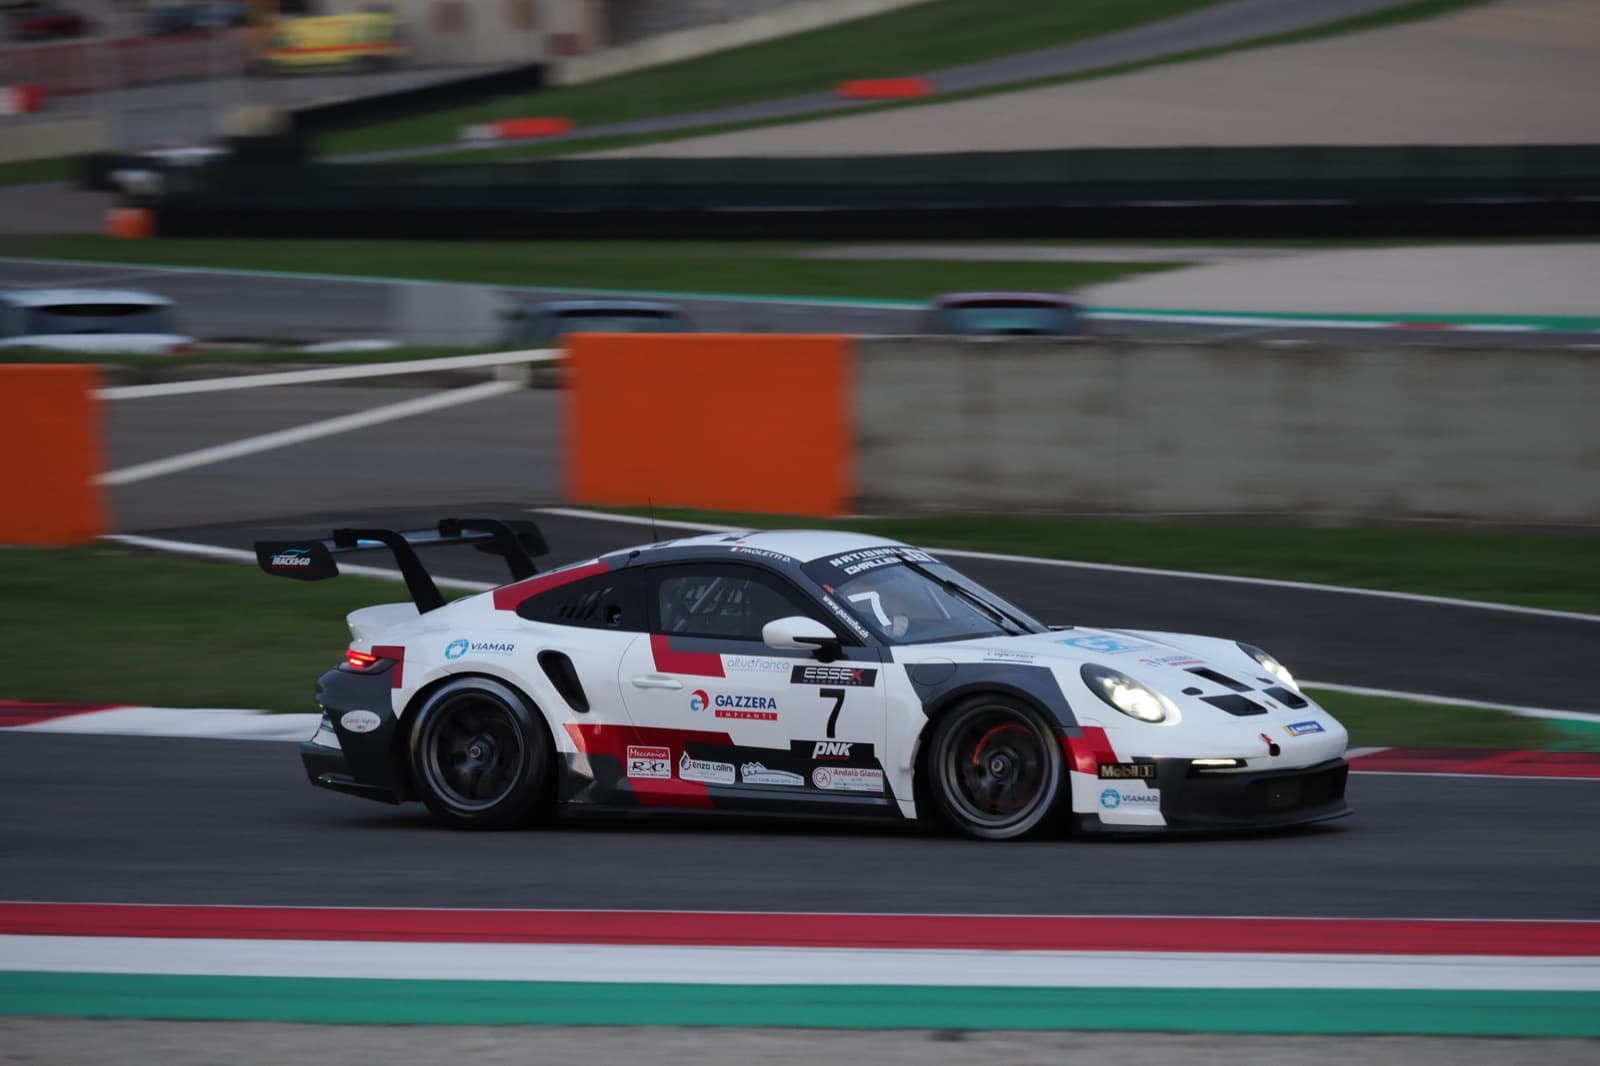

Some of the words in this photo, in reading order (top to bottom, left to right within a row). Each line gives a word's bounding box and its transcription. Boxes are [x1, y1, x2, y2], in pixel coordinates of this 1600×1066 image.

[829, 547, 902, 567] NATIONAL
[847, 591, 892, 627] 7
[471, 643, 515, 652] VIAMAR
[804, 667, 865, 680] ESSEX
[715, 694, 777, 709] GAZZERA
[719, 711, 774, 719] IMPIANTI
[819, 688, 846, 738] 7
[693, 761, 711, 770] Enzo
[712, 763, 733, 773] Lollini
[860, 769, 882, 778] Gianni
[1101, 764, 1138, 777] Mobil
[1121, 794, 1159, 802] VIAMAR
